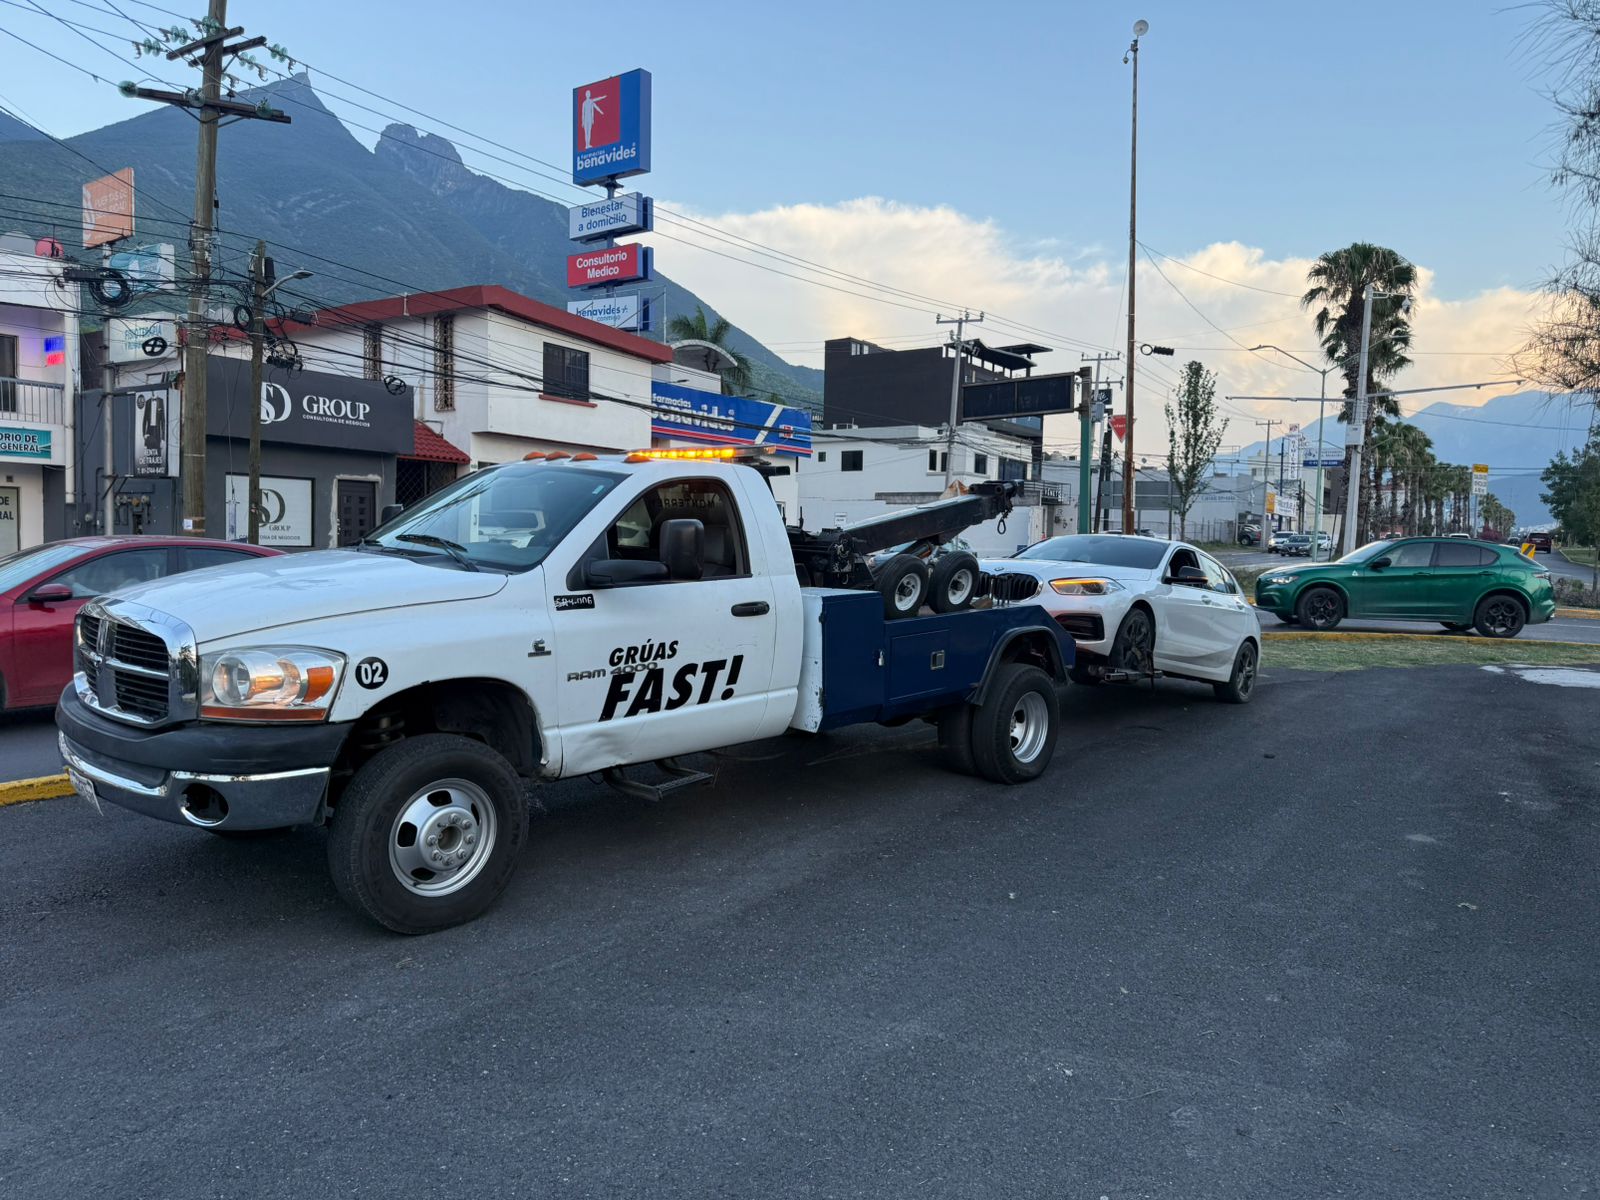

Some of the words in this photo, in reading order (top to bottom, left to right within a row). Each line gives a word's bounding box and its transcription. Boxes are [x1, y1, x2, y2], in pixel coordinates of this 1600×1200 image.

[577, 144, 636, 171] benavides
[582, 199, 624, 218] Bienestar
[578, 222, 584, 232] a
[587, 213, 627, 230] domicilio
[576, 252, 627, 268] Consultorio
[587, 265, 620, 279] Medico
[302, 395, 370, 420] GROUP
[1, 442, 40, 453] GENERAL
[25, 434, 38, 444] DE
[608, 639, 679, 667] GRÚAS
[360, 662, 384, 685] 02
[567, 669, 606, 682] RAM
[610, 662, 658, 675] 4000
[598, 654, 744, 722] FAST!
